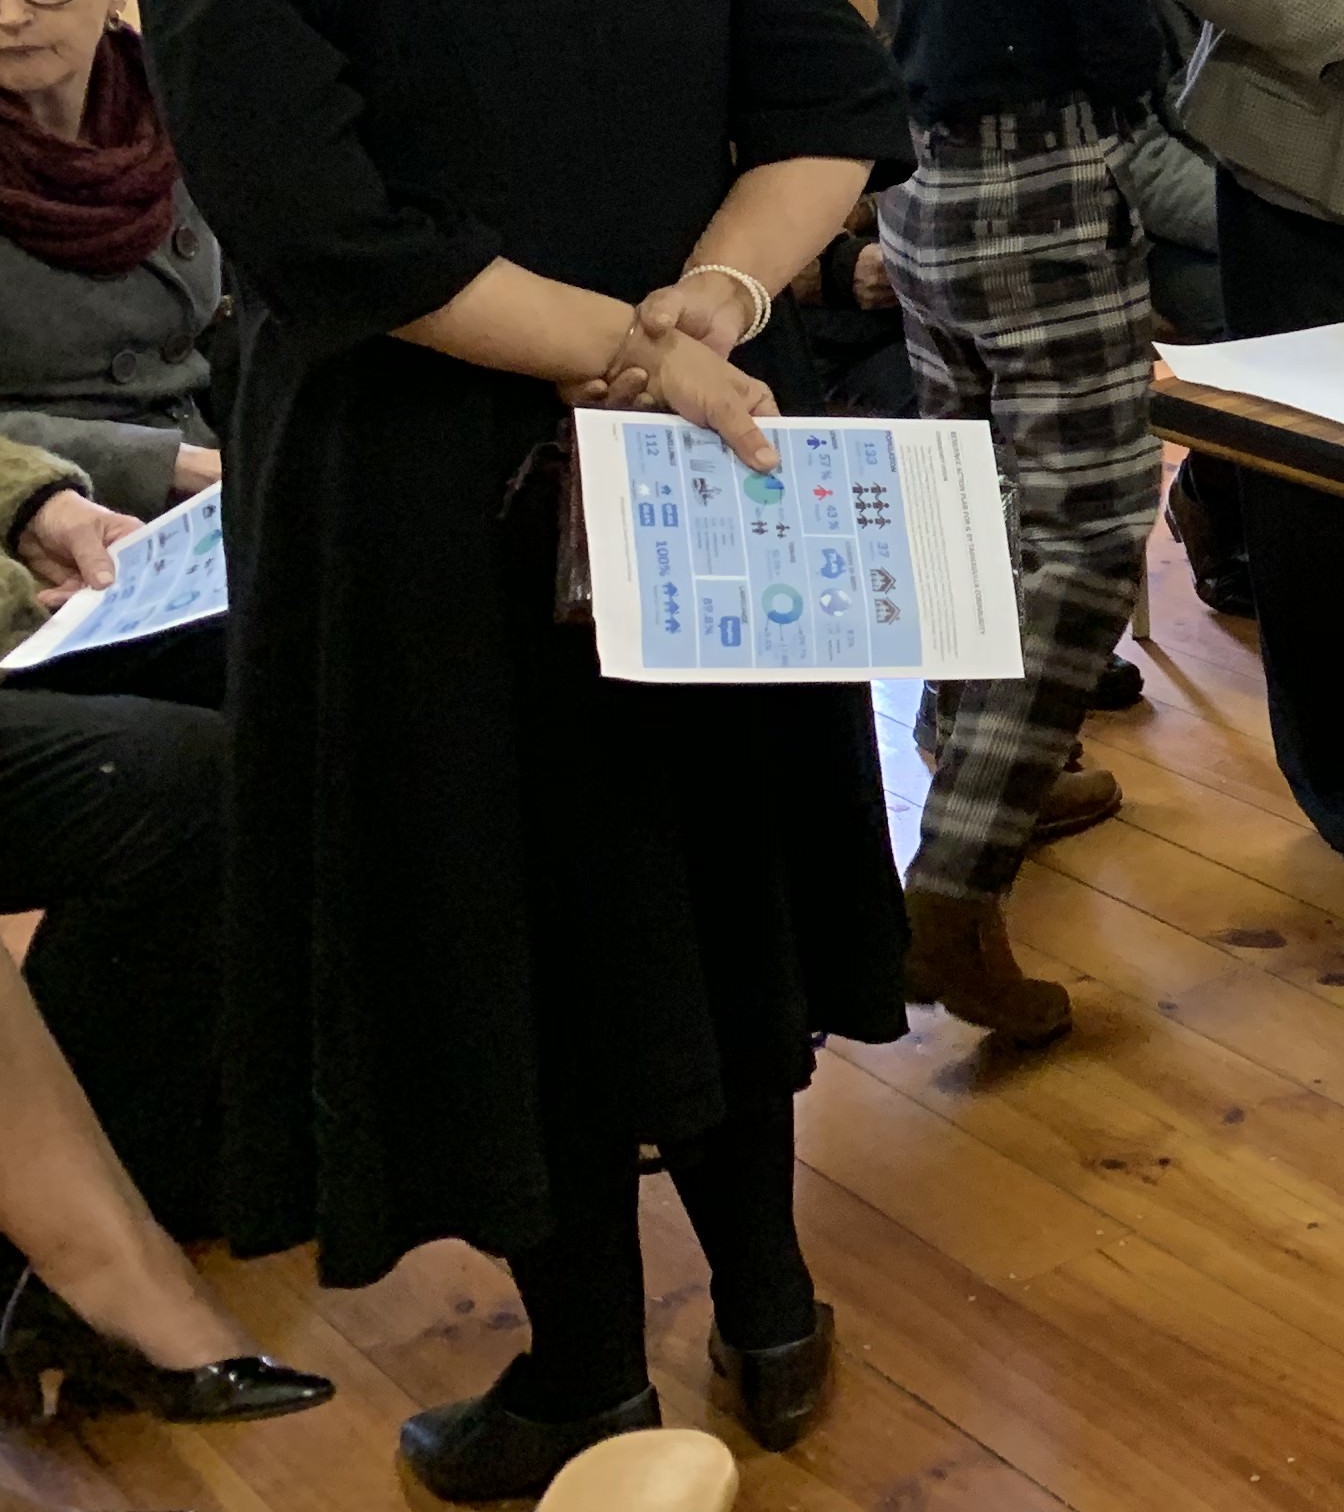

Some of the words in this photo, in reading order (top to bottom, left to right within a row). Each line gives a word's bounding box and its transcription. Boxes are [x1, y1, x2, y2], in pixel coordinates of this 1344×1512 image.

[645, 432, 660, 457] 112
[819, 453, 832, 467] 57
[827, 504, 838, 518] 43
[864, 442, 878, 465] 133
[878, 542, 890, 559] 37
[655, 540, 671, 577] 100%
